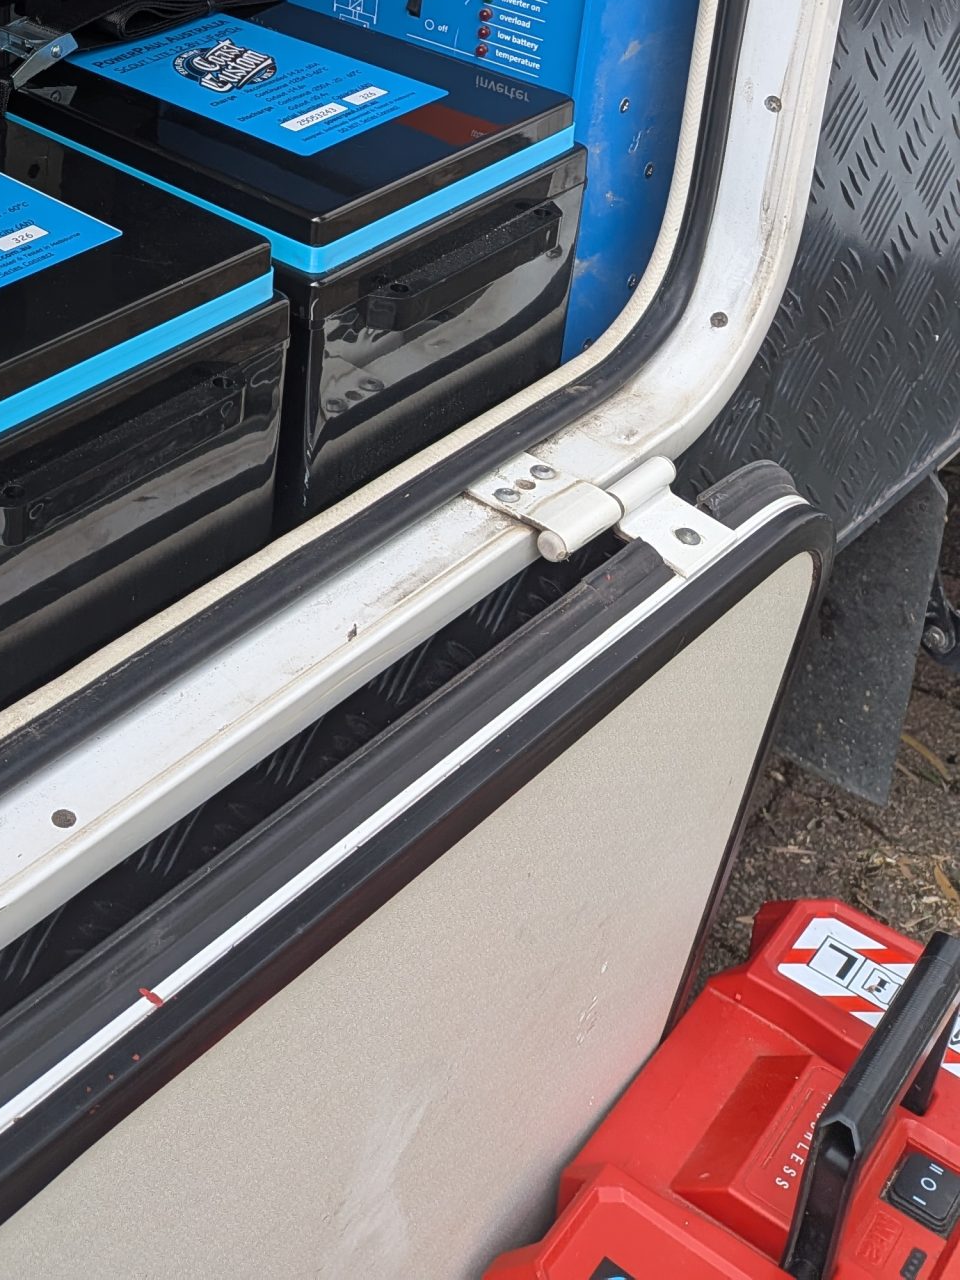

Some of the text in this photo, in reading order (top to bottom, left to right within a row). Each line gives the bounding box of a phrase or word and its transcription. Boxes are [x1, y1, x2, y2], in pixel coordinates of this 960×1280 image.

[531, 3, 541, 12] on
[438, 24, 449, 33] off
[499, 13, 531, 29] overload
[497, 30, 539, 52] low battery
[192, 38, 240, 73] Coast
[495, 49, 541, 70] temperature
[356, 91, 378, 100] 326
[293, 107, 339, 126] 25053243
[9, 231, 36, 244] 326
[20, 251, 55, 267] Connect
